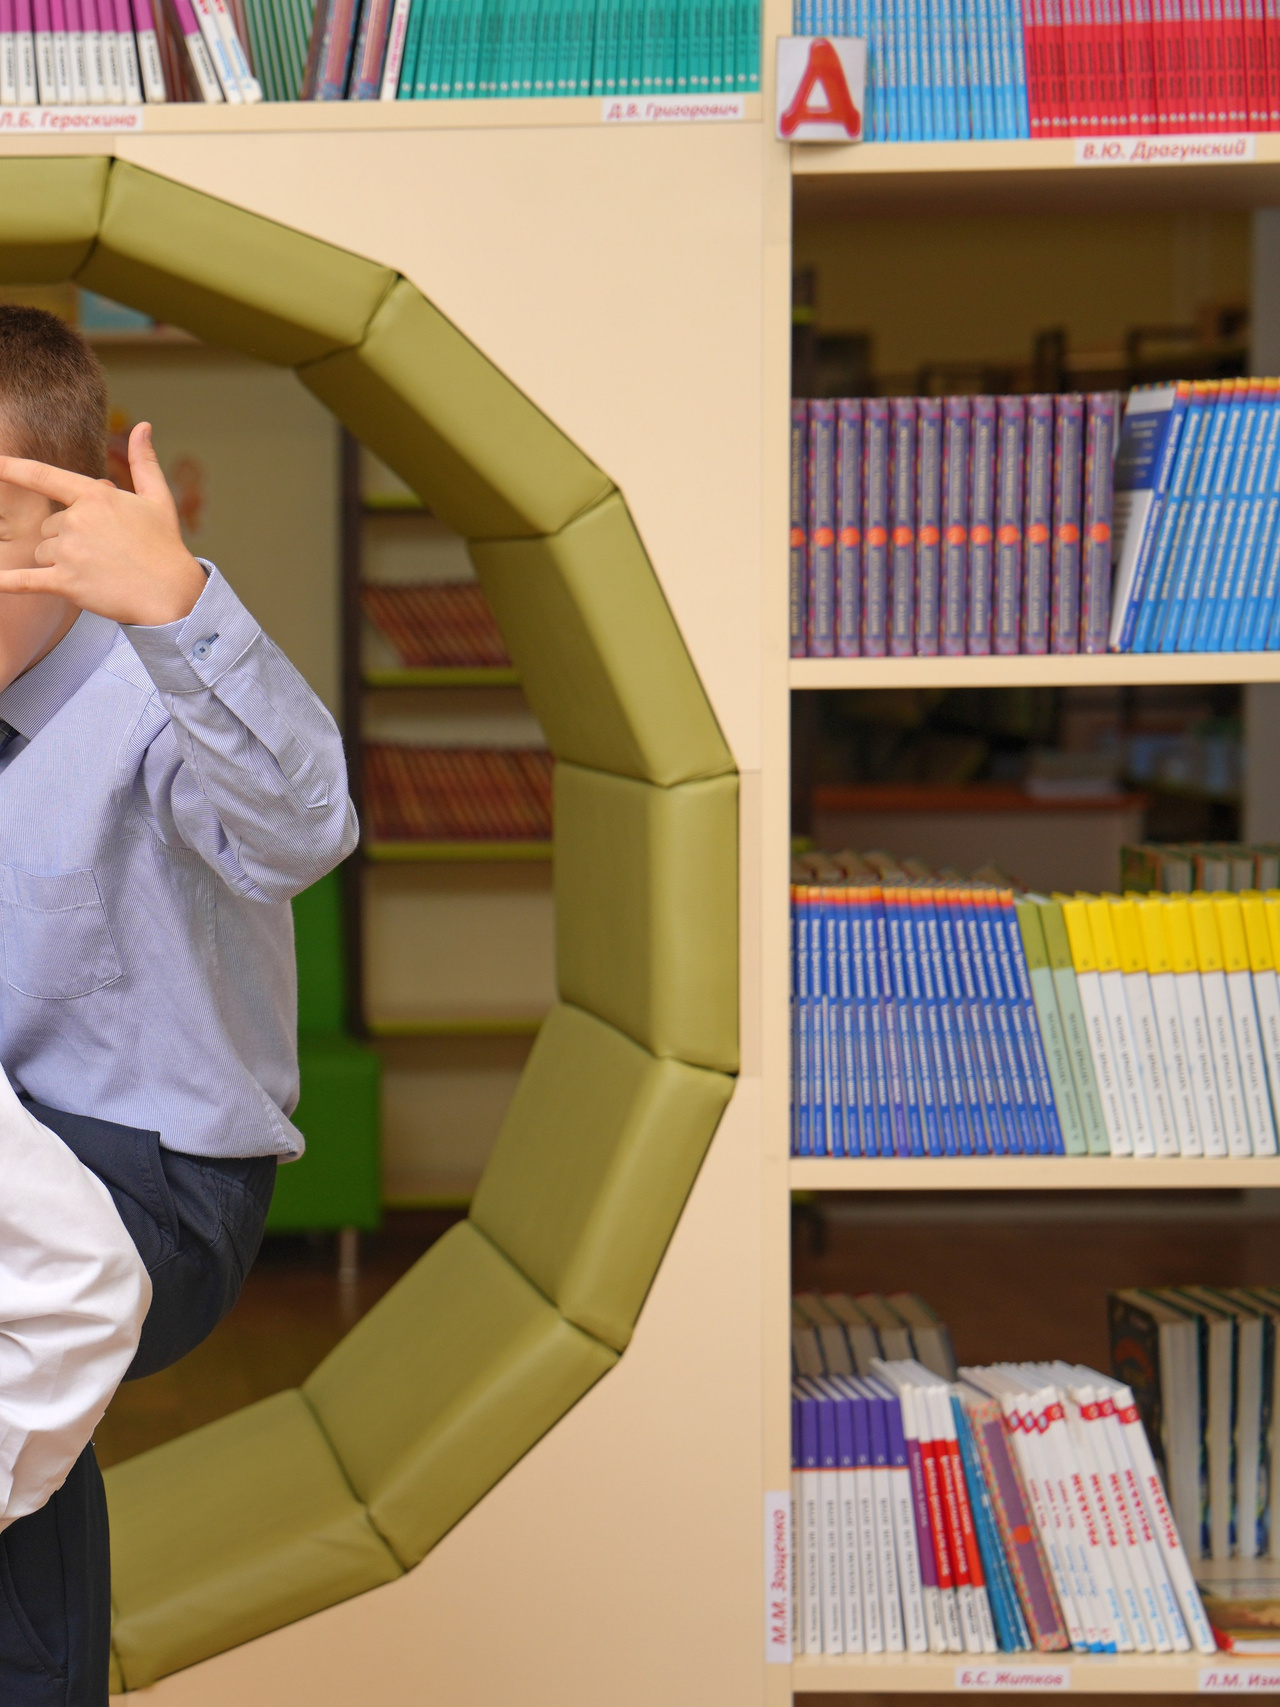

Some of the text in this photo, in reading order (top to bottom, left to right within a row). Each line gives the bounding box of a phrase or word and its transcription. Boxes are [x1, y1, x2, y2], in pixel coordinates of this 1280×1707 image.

[607, 102, 739, 120] Д.В. Григорович
[41, 111, 137, 131] Гераскина
[1082, 139, 1248, 163] В.Ю. Драгунский
[770, 1508, 789, 1646] М.М. Зощенко
[960, 1671, 1064, 1687] Б.С. Житков
[1205, 1673, 1243, 1687] Л.М.
